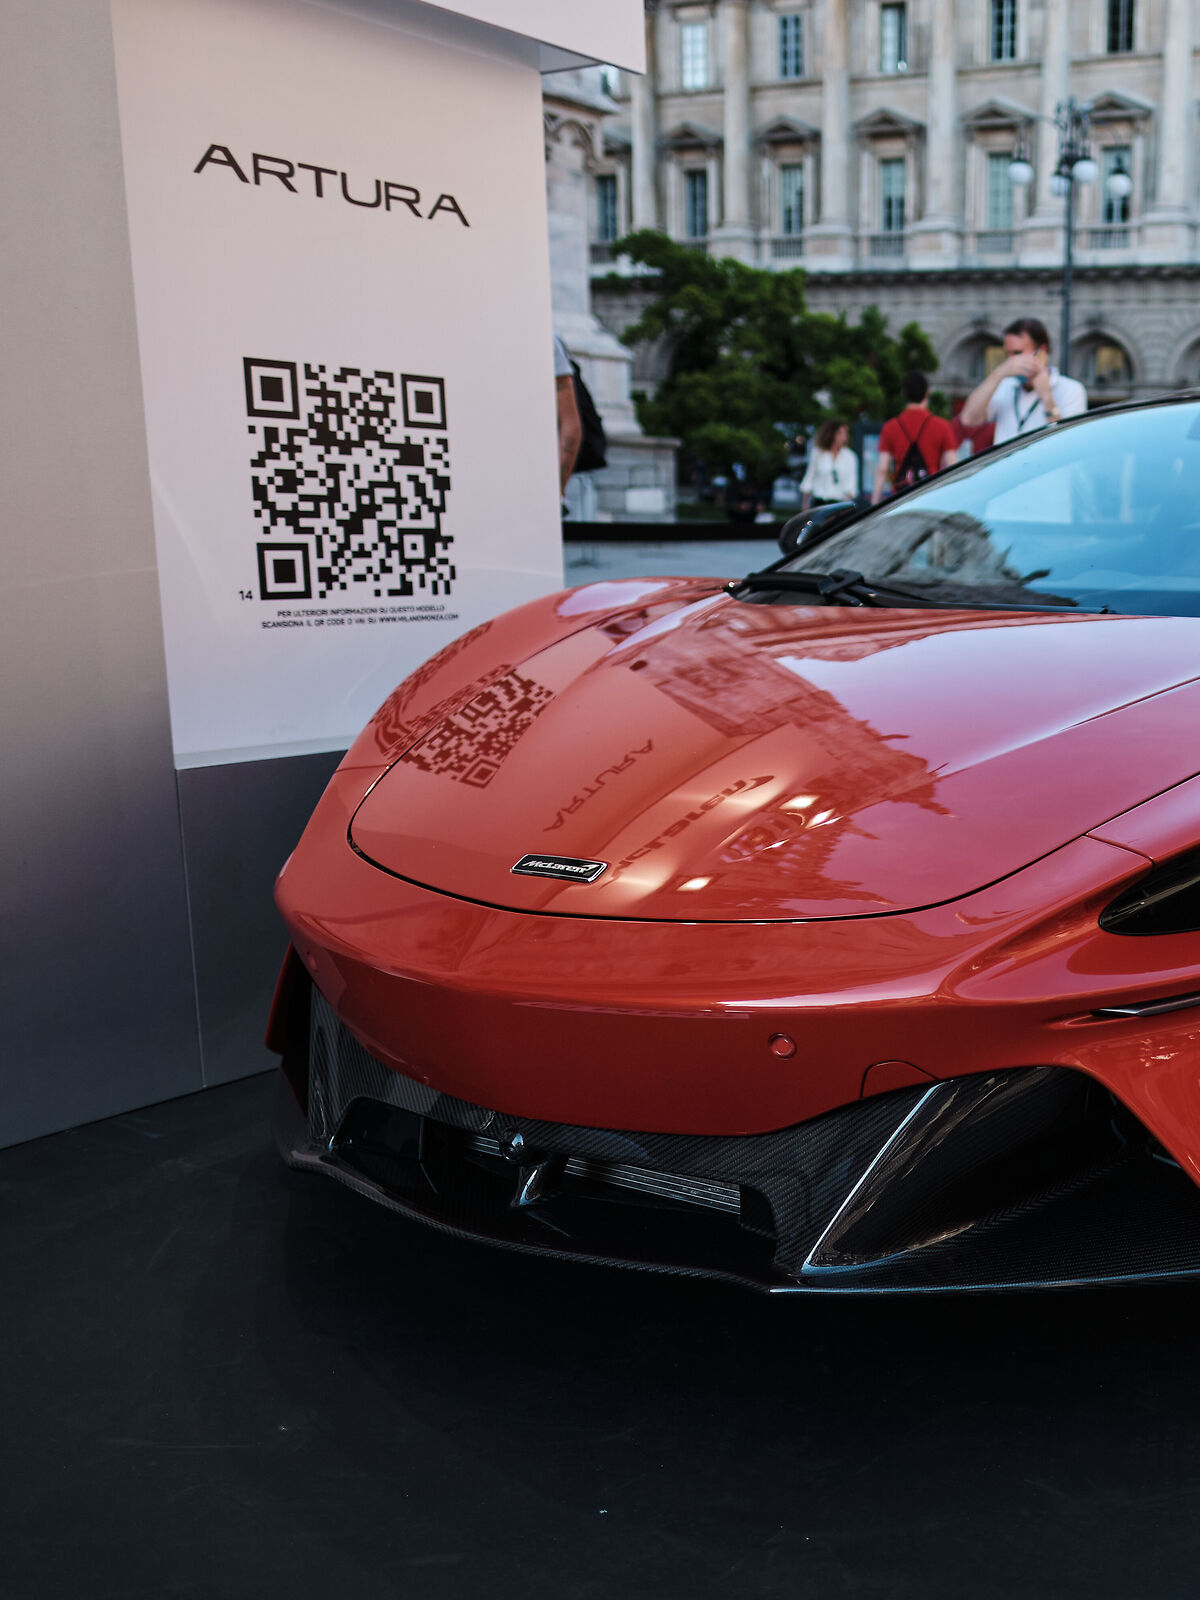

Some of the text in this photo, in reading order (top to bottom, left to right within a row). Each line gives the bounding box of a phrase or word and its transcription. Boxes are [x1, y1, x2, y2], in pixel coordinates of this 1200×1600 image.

[193, 143, 471, 228] ARTURA
[238, 590, 253, 601] 14
[389, 605, 415, 614] QUESTO
[416, 604, 445, 612] MODELLO
[262, 620, 304, 629] SCANSIONA
[326, 618, 345, 626] CODE
[521, 860, 589, 874] McLaren
